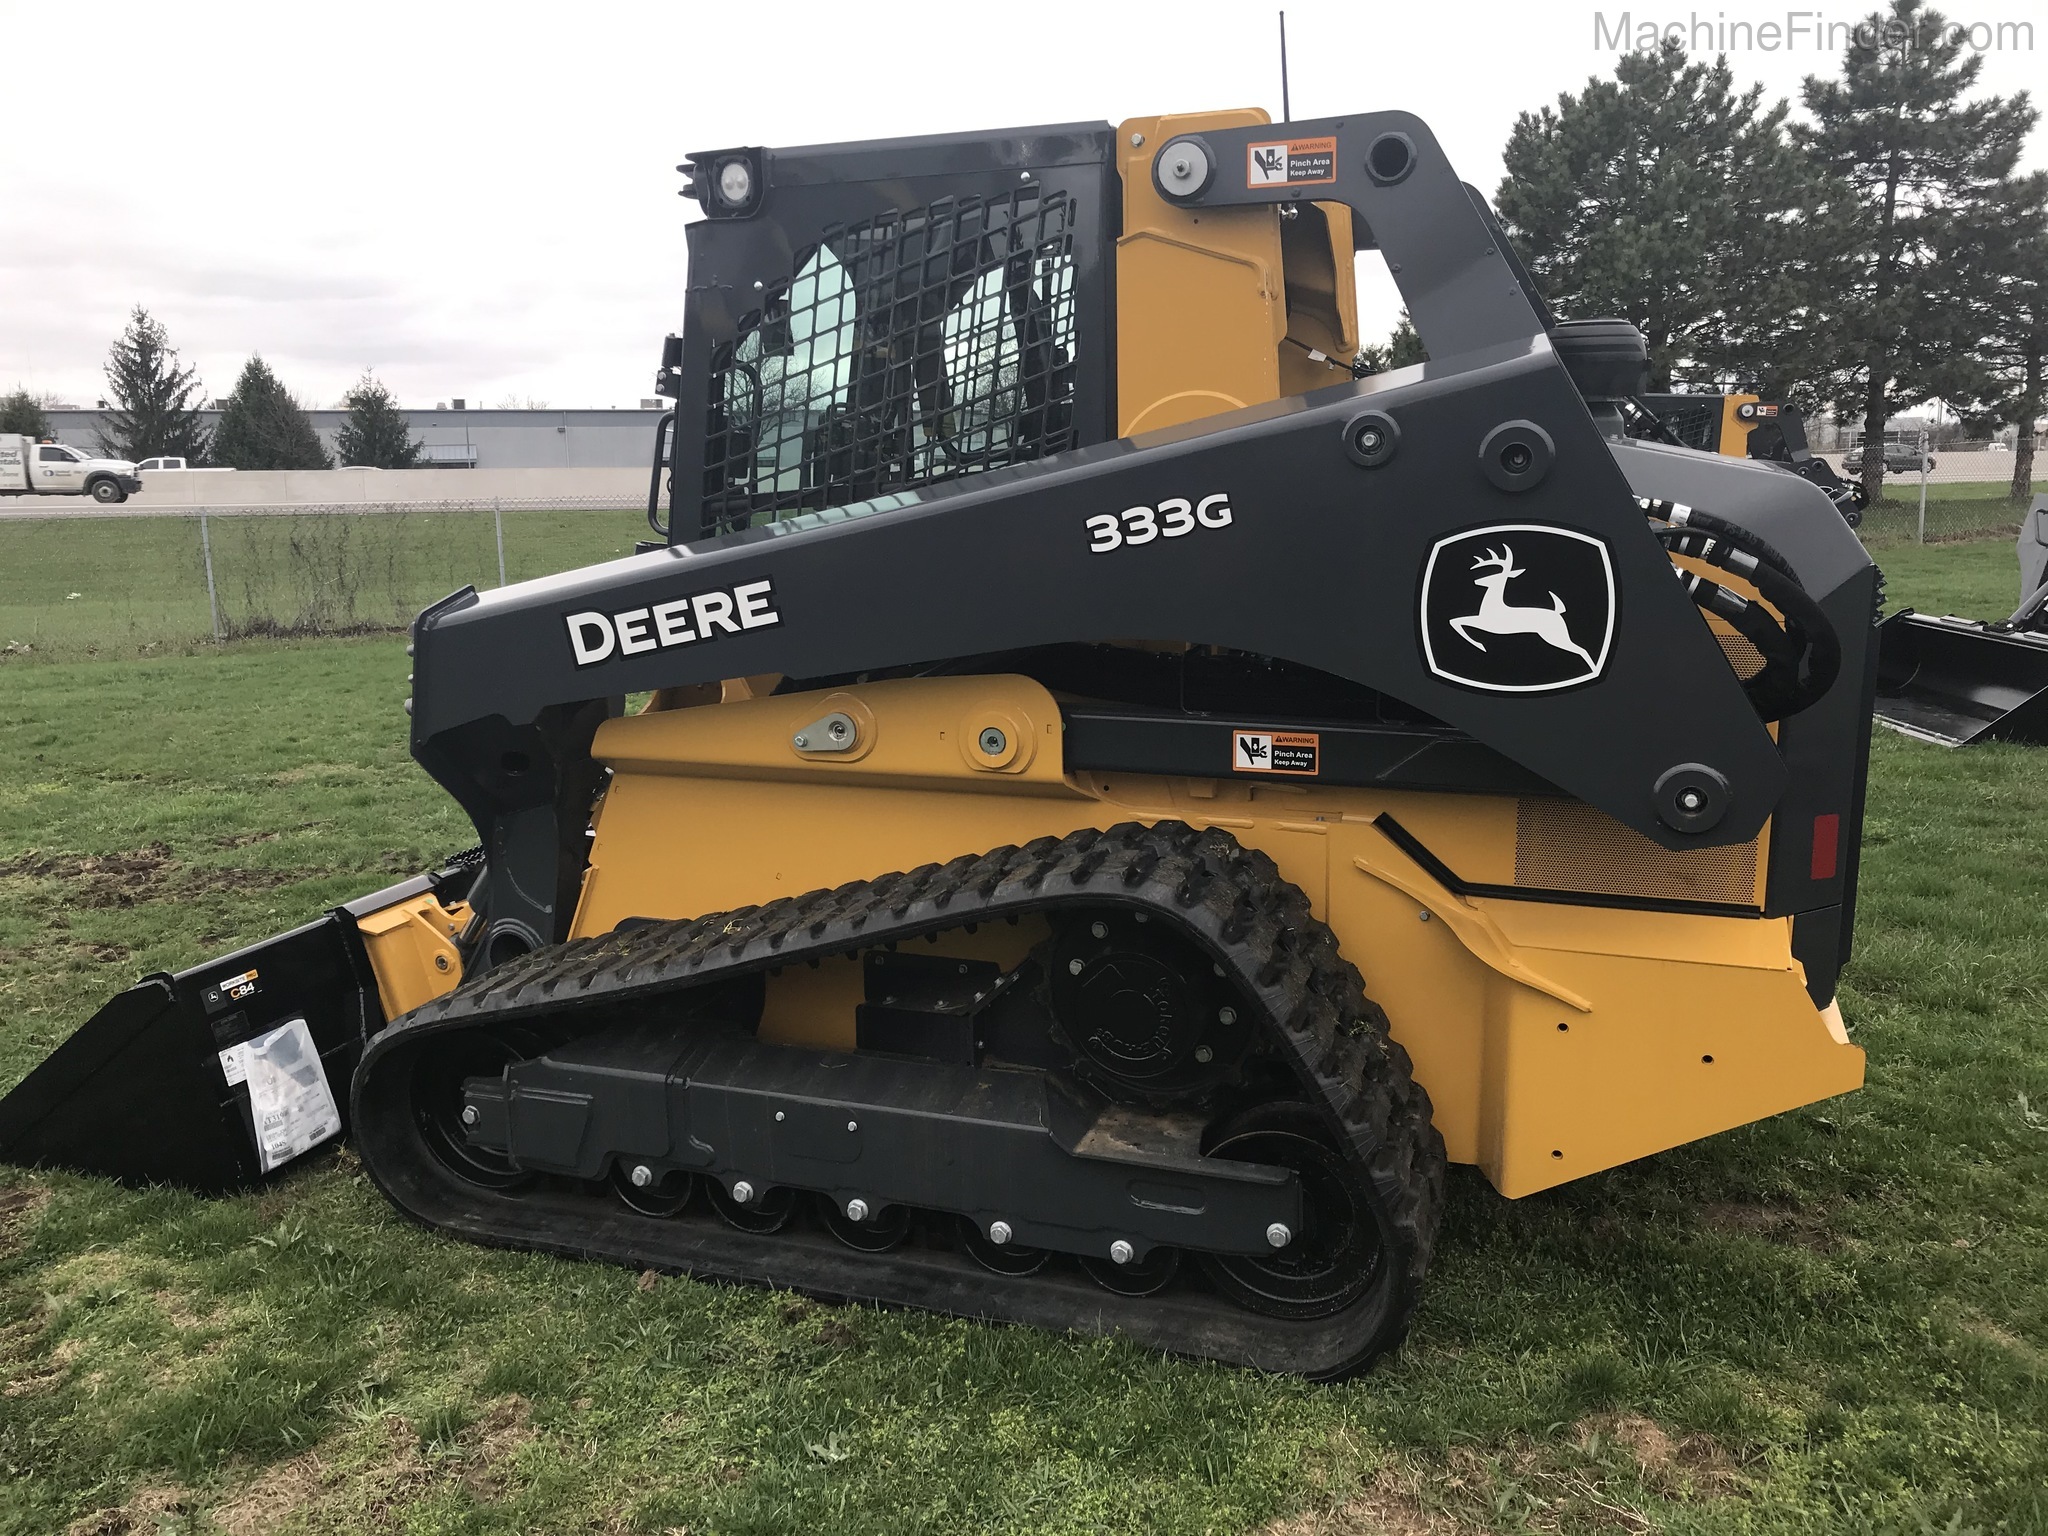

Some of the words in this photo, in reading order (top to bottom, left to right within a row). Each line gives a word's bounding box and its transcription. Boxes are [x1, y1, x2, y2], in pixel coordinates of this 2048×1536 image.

[1298, 142, 1332, 151] WARNING
[1290, 159, 1311, 168] Pinch
[1312, 158, 1330, 166] Area
[1290, 169, 1306, 177] Keep
[1307, 168, 1325, 176] Away
[1086, 493, 1233, 553] 333G
[566, 580, 779, 666] DEERE
[1274, 750, 1295, 758] Pinch
[1296, 751, 1313, 759] Area
[1290, 760, 1308, 768] Away
[231, 982, 255, 998] C84
